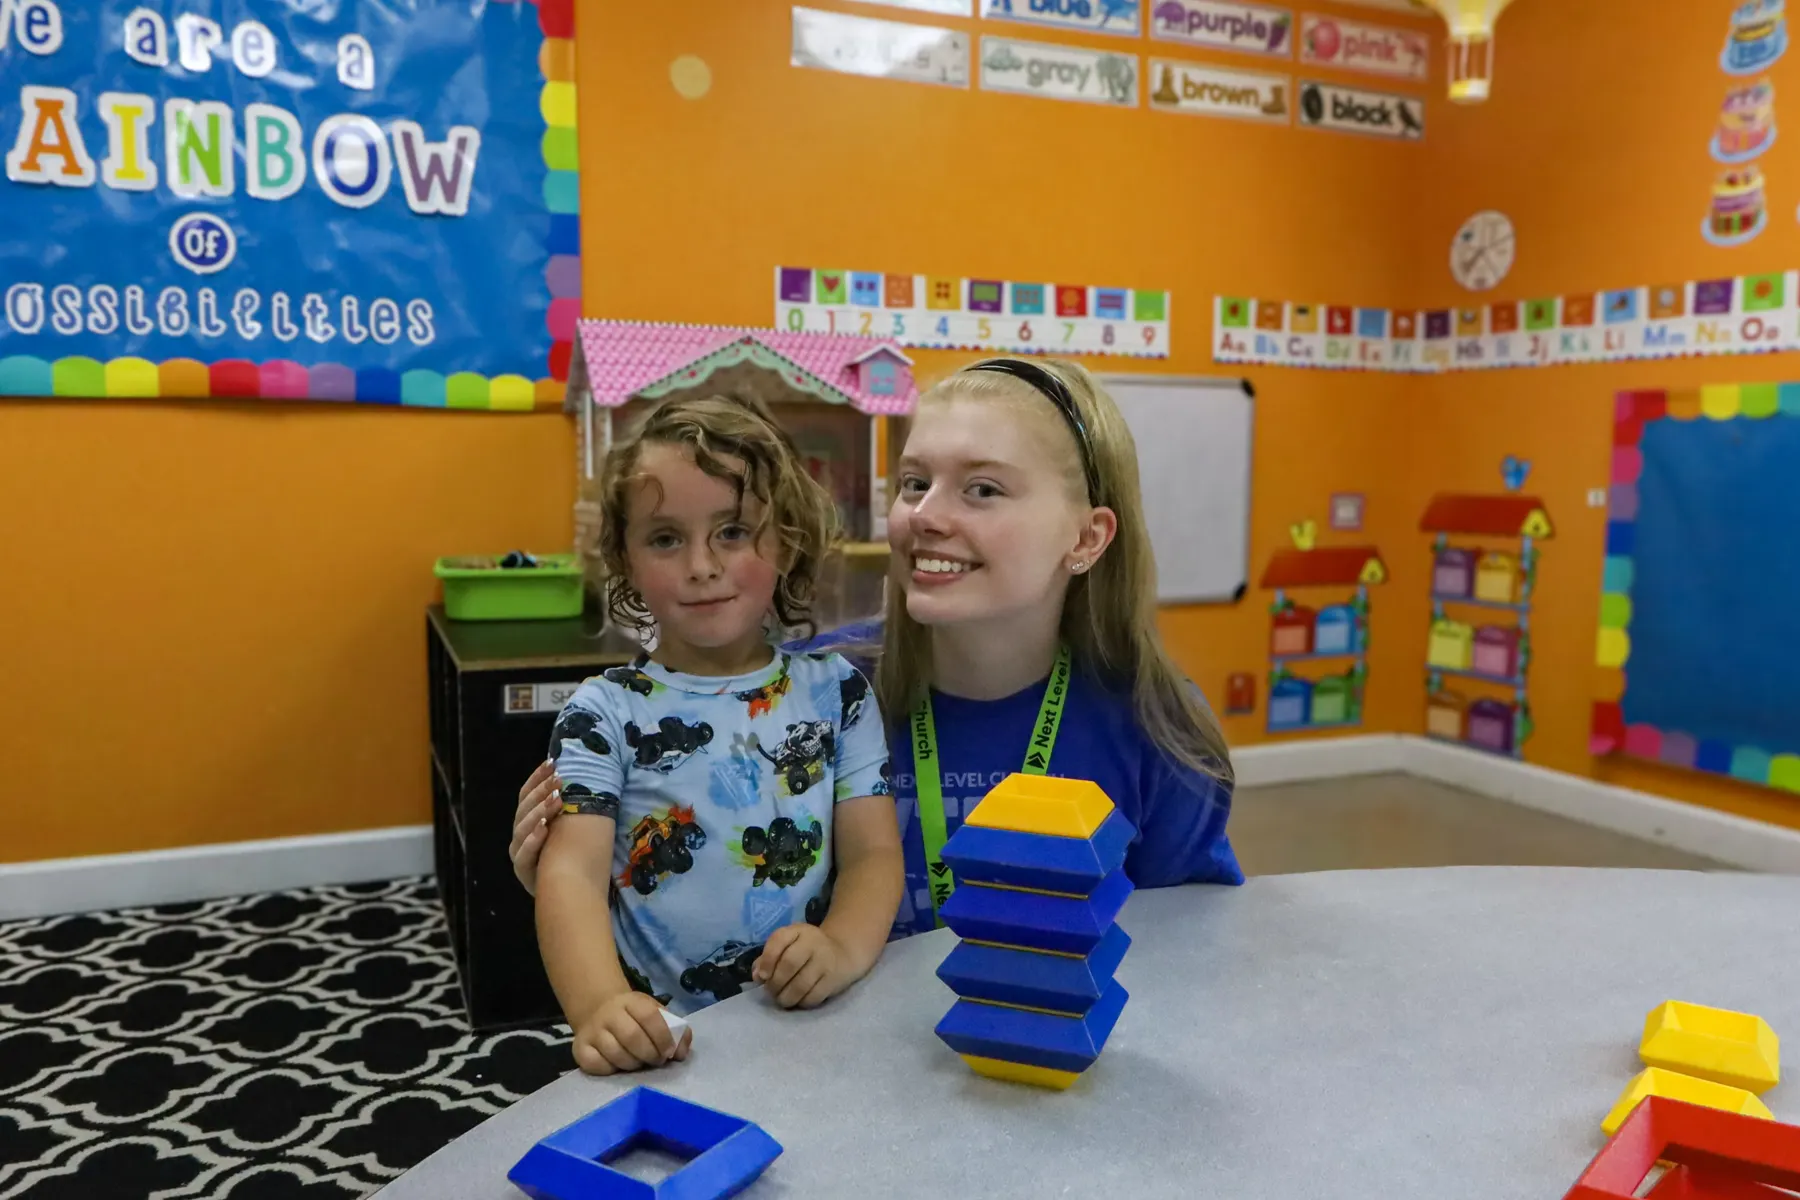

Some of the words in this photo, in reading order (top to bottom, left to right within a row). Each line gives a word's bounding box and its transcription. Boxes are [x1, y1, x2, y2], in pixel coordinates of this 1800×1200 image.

[130, 11, 273, 74] are
[1187, 9, 1268, 41] purple
[1343, 28, 1398, 62] pink
[1026, 57, 1091, 92] gray
[1181, 72, 1262, 107] brown
[1331, 92, 1395, 127] black
[787, 308, 804, 332] 0
[826, 309, 836, 335] 1
[859, 311, 874, 336] 2
[891, 312, 906, 337] 3
[935, 316, 949, 337] 4
[977, 317, 992, 341] 5
[1017, 320, 1033, 342] 6
[1061, 321, 1077, 344] 7
[1102, 323, 1116, 346] 8
[1141, 325, 1156, 347] 9
[1033, 708, 1058, 749] Next
[1047, 661, 1069, 707] Level
[889, 773, 917, 789] NEX
